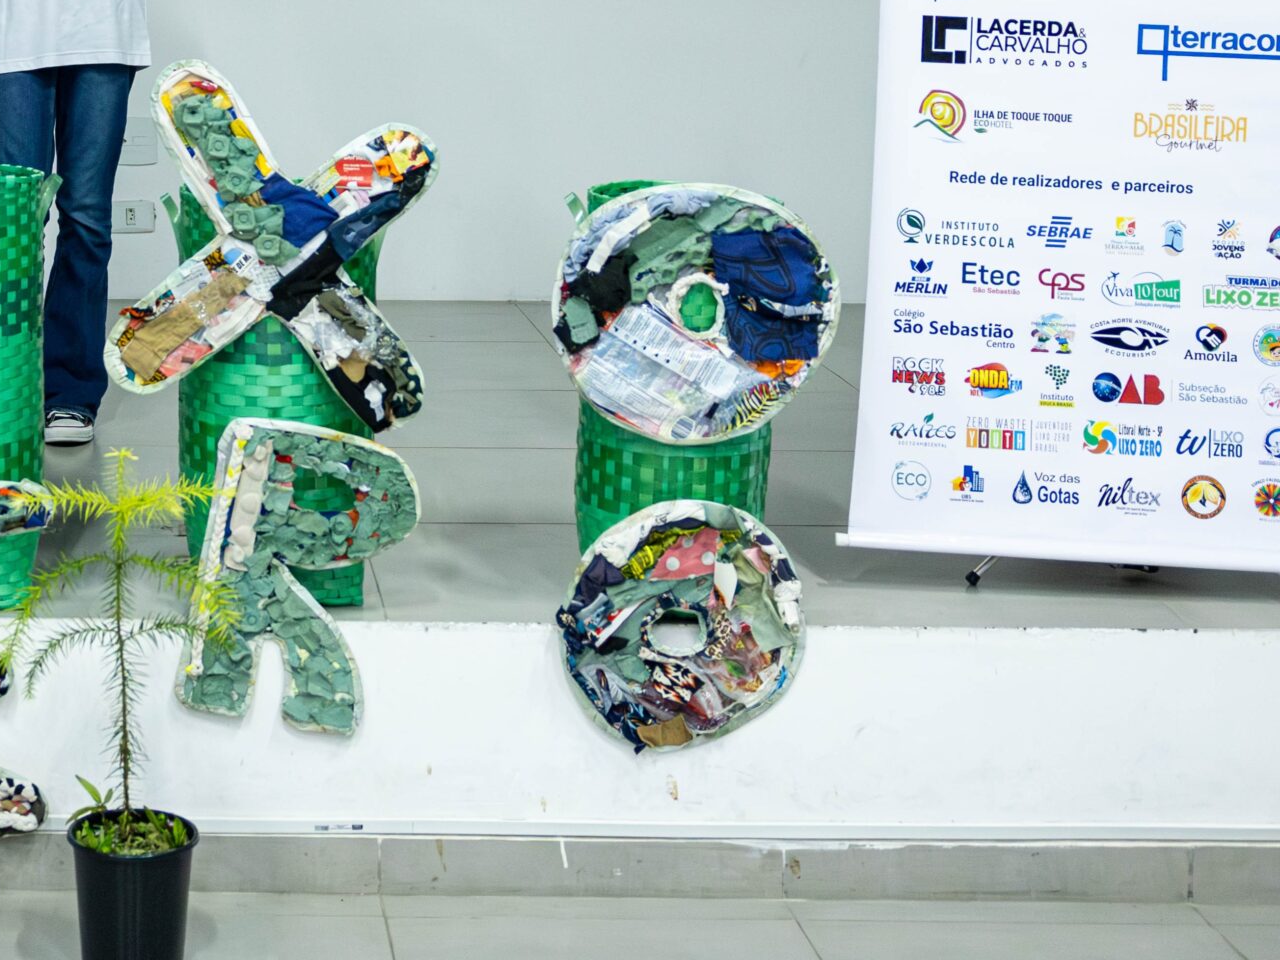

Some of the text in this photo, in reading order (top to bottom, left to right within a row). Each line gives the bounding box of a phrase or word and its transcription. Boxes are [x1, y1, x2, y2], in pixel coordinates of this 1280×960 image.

[976, 34, 1088, 55] CARVALHO
[976, 57, 1087, 68] ADVOGADOS
[973, 110, 1073, 123] ILHA DE TOQUE TOQUE
[1134, 112, 1248, 142] BRASILEIRA
[1155, 133, 1223, 153] Gourmet
[949, 171, 1194, 195] Rede de realizadores e parceiros
[941, 221, 999, 232] INSTITUTO
[1026, 225, 1093, 240] SEBRAE
[925, 234, 1015, 248] VERDESCOLA
[1212, 244, 1245, 252] JOVENS
[961, 261, 1020, 286] Etec
[894, 281, 948, 295] MERLIN
[1228, 277, 1267, 286] TURMA
[972, 286, 1020, 295] São Sebastião
[1105, 283, 1133, 298] Viva
[1205, 289, 1252, 306] LIXO
[893, 308, 925, 319] Colégio
[893, 319, 923, 334] São
[929, 321, 1014, 339] Sebastião
[986, 340, 1015, 349] Centro
[1105, 347, 1157, 358] ECOTURISMO
[1184, 349, 1238, 362] Amovila
[892, 356, 945, 372] ROCK
[892, 371, 946, 385] NEWS
[970, 368, 1009, 390] ONDA
[919, 385, 946, 397] 98.5
[1178, 382, 1226, 395] Subseção
[1040, 392, 1074, 402] Instituto
[1178, 393, 1248, 405] São Sebastião
[966, 416, 1026, 430] ZERO WASTE
[966, 428, 1026, 450] YOUTH
[1213, 430, 1244, 443] LIXO
[1119, 438, 1163, 457] LIXO ZERO
[1213, 442, 1243, 458] ZERO
[896, 472, 927, 486] ECO
[1034, 472, 1081, 484] Voz das
[1037, 486, 1080, 505] Gotas
